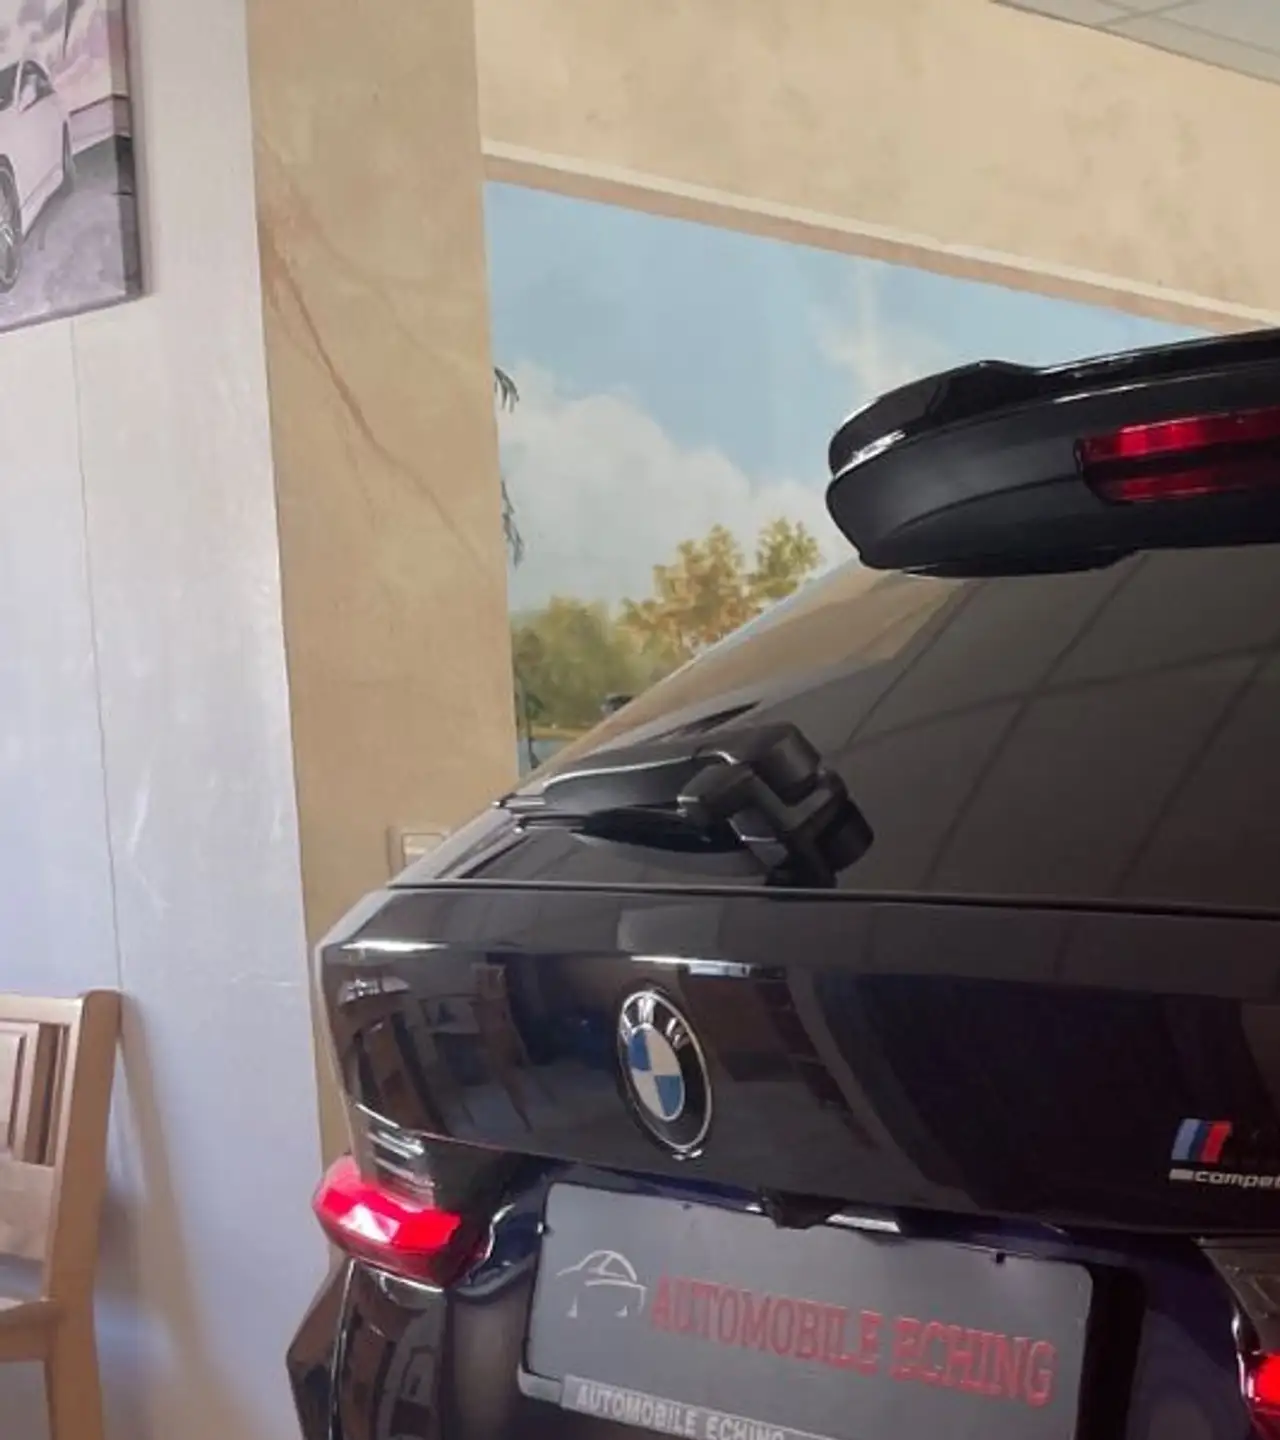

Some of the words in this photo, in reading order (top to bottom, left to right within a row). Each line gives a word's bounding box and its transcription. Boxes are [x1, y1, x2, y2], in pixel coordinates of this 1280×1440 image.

[651, 1272, 882, 1377] AUTOMOBILE
[889, 1316, 1057, 1408] ECHING
[576, 1383, 697, 1438] AUTOMOBILE
